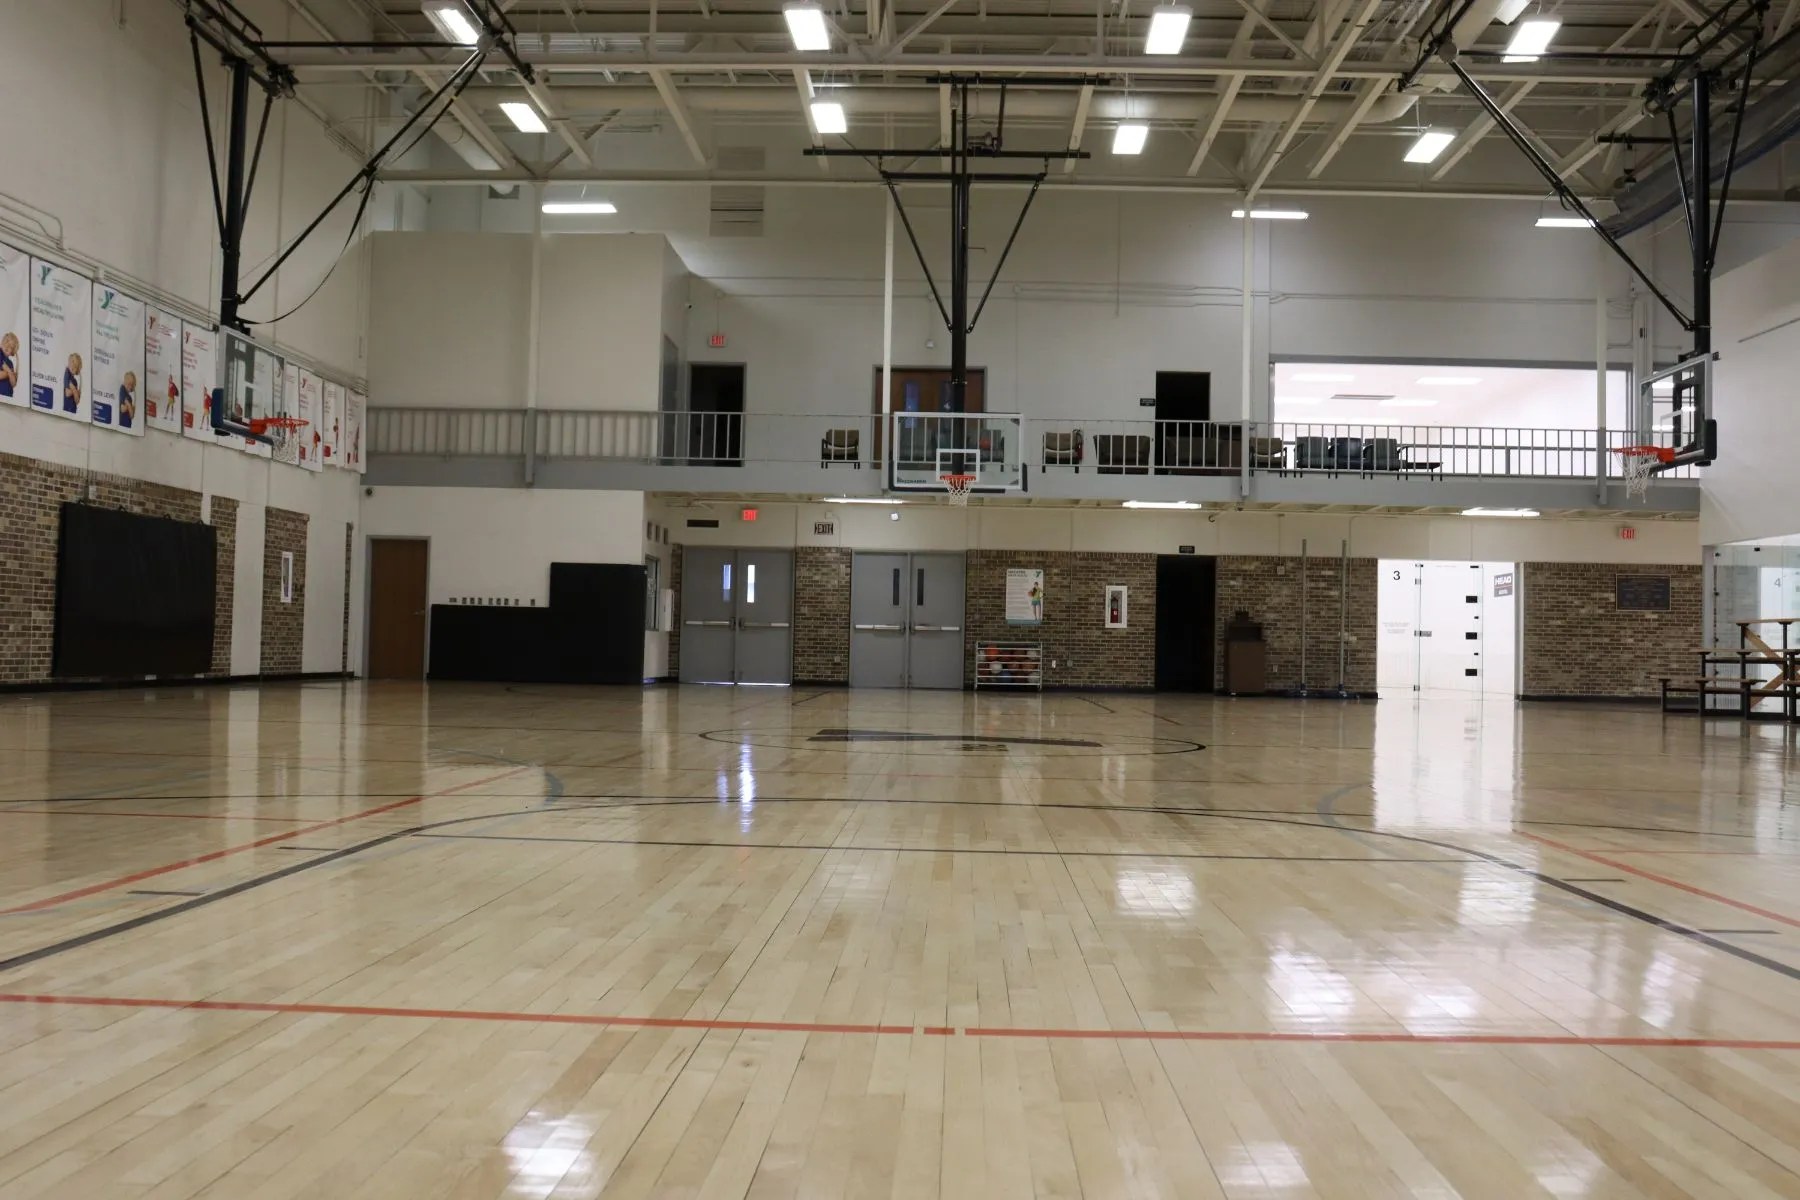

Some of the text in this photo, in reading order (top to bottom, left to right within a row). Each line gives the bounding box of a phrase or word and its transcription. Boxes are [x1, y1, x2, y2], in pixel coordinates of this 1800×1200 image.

[743, 510, 757, 521] EXIT
[817, 523, 831, 534] EXIT
[1621, 528, 1635, 539] EXIT
[1393, 570, 1401, 581] 3
[1774, 577, 1781, 588] 4
